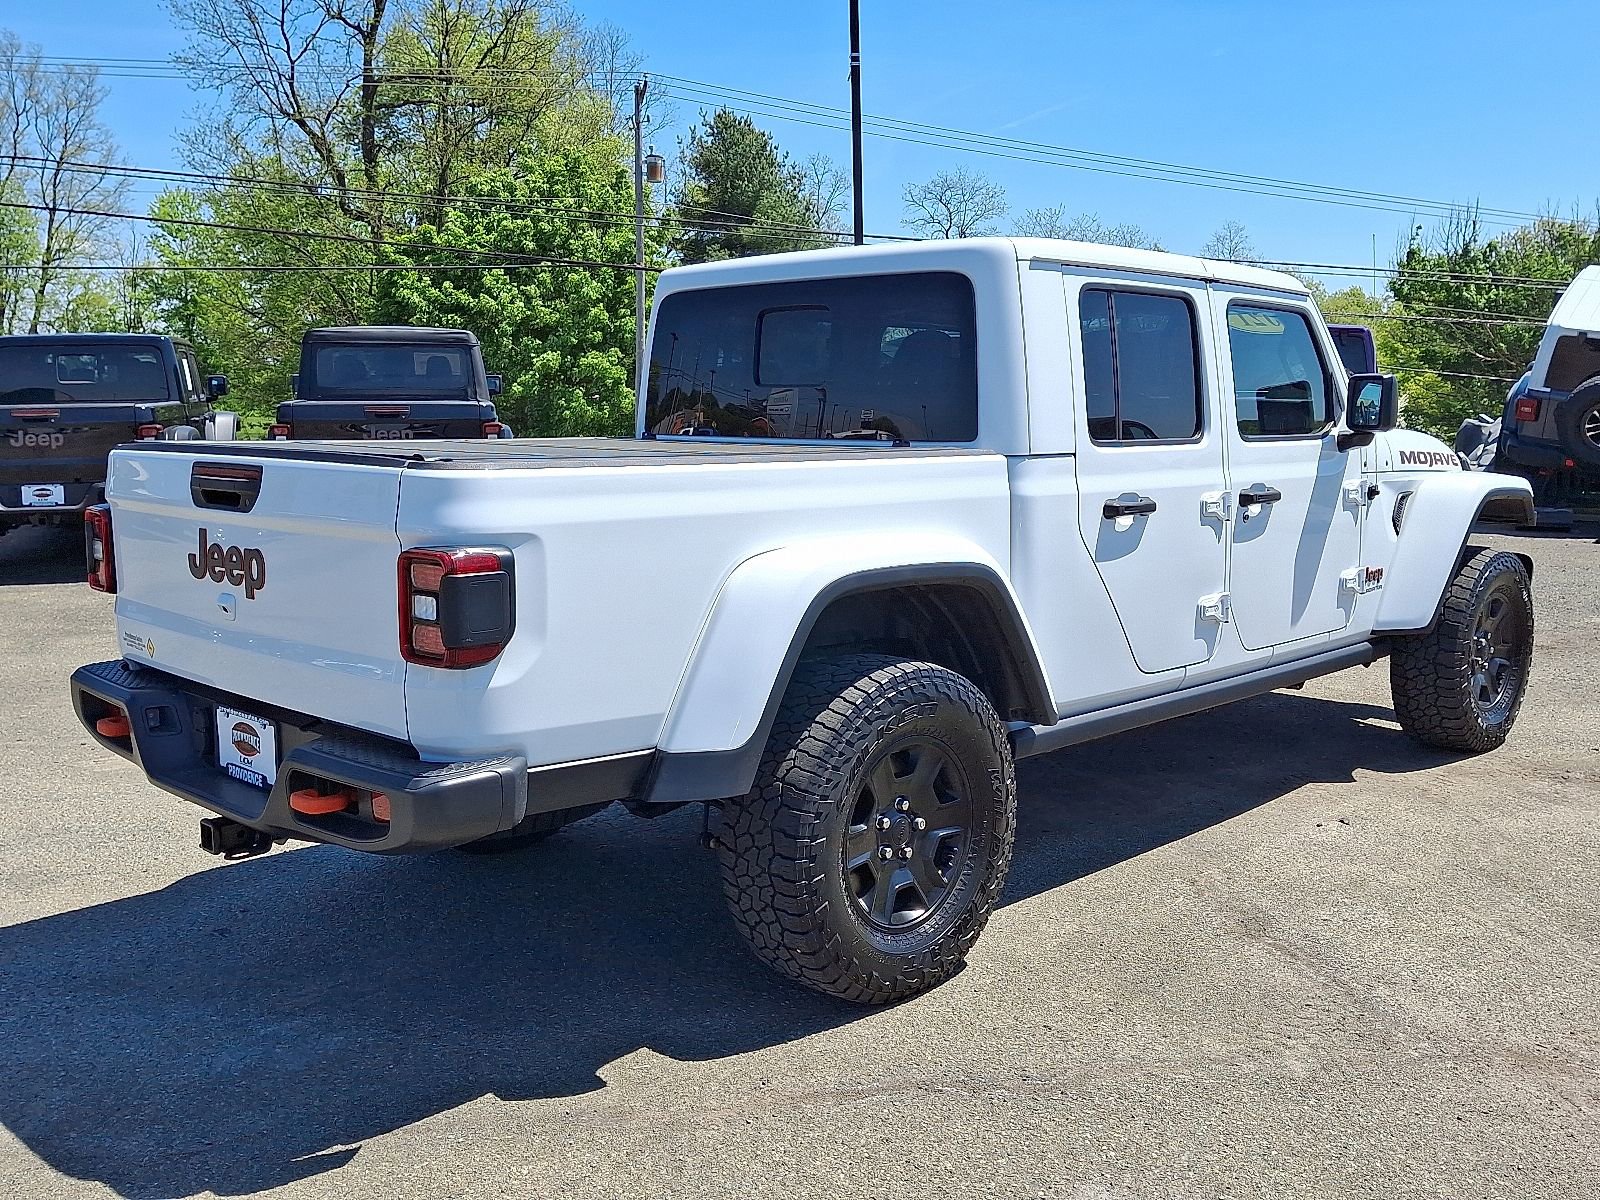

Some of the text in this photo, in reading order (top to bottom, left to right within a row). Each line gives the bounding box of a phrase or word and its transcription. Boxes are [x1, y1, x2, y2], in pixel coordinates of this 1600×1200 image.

[9, 429, 64, 449] Jeep
[1399, 450, 1459, 467] MOJAVE
[187, 527, 266, 600] Jeep
[227, 764, 263, 787] PROVIDENCE
